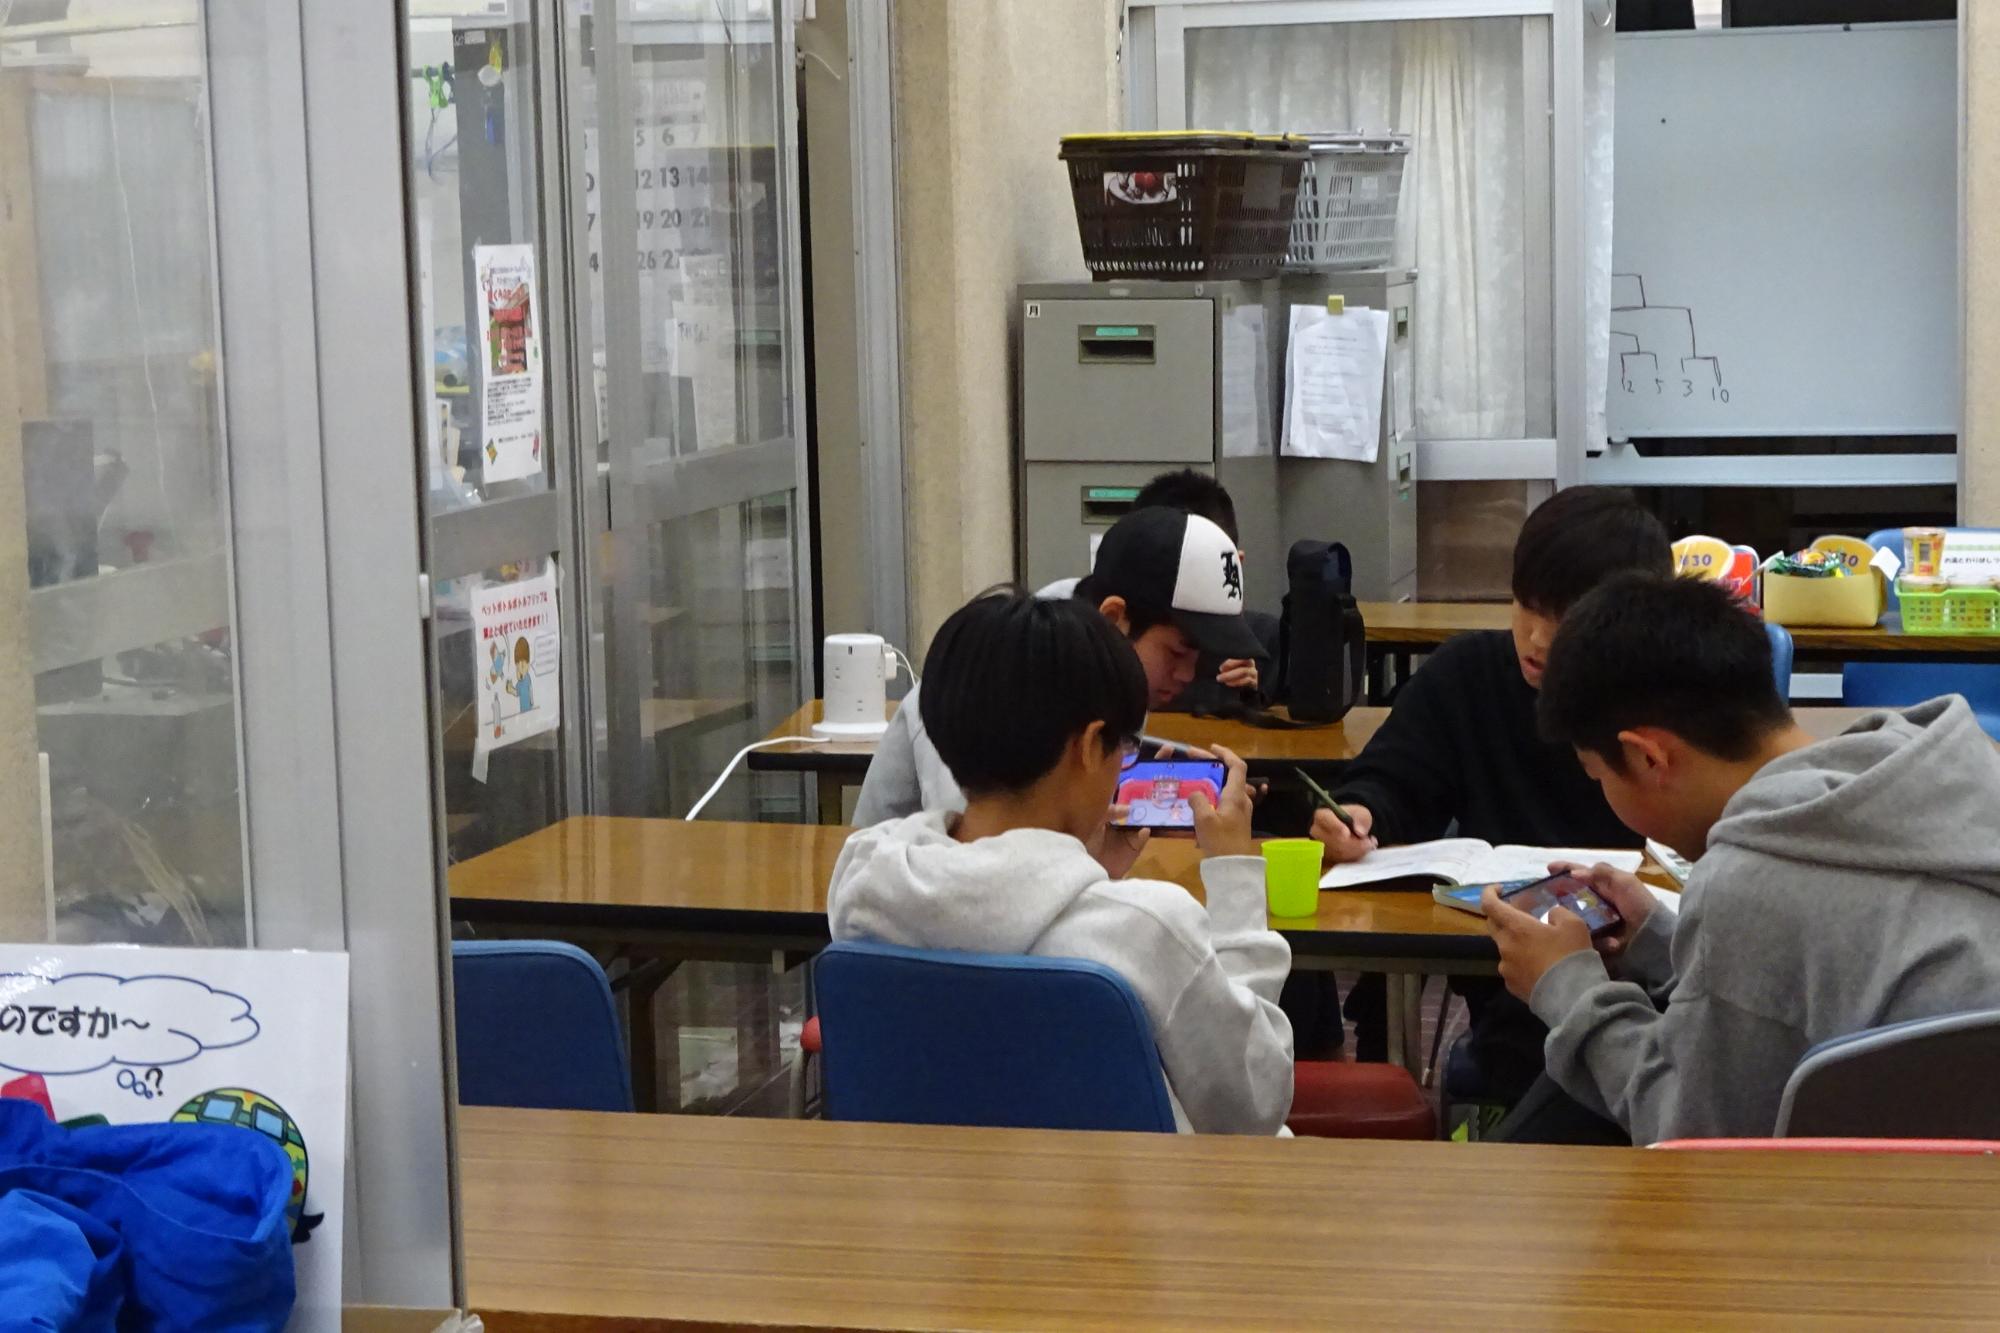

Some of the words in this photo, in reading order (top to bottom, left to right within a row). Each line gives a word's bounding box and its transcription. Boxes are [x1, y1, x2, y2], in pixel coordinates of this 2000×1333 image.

[636, 129, 646, 147] 5
[662, 127, 675, 147] 6
[660, 166, 680, 189] 13
[687, 165, 709, 189] 14
[661, 208, 682, 229] 20
[691, 207, 711, 229] 21
[638, 250, 656, 270] 26
[1682, 379, 1693, 397] 3
[1712, 387, 1730, 404] 10
